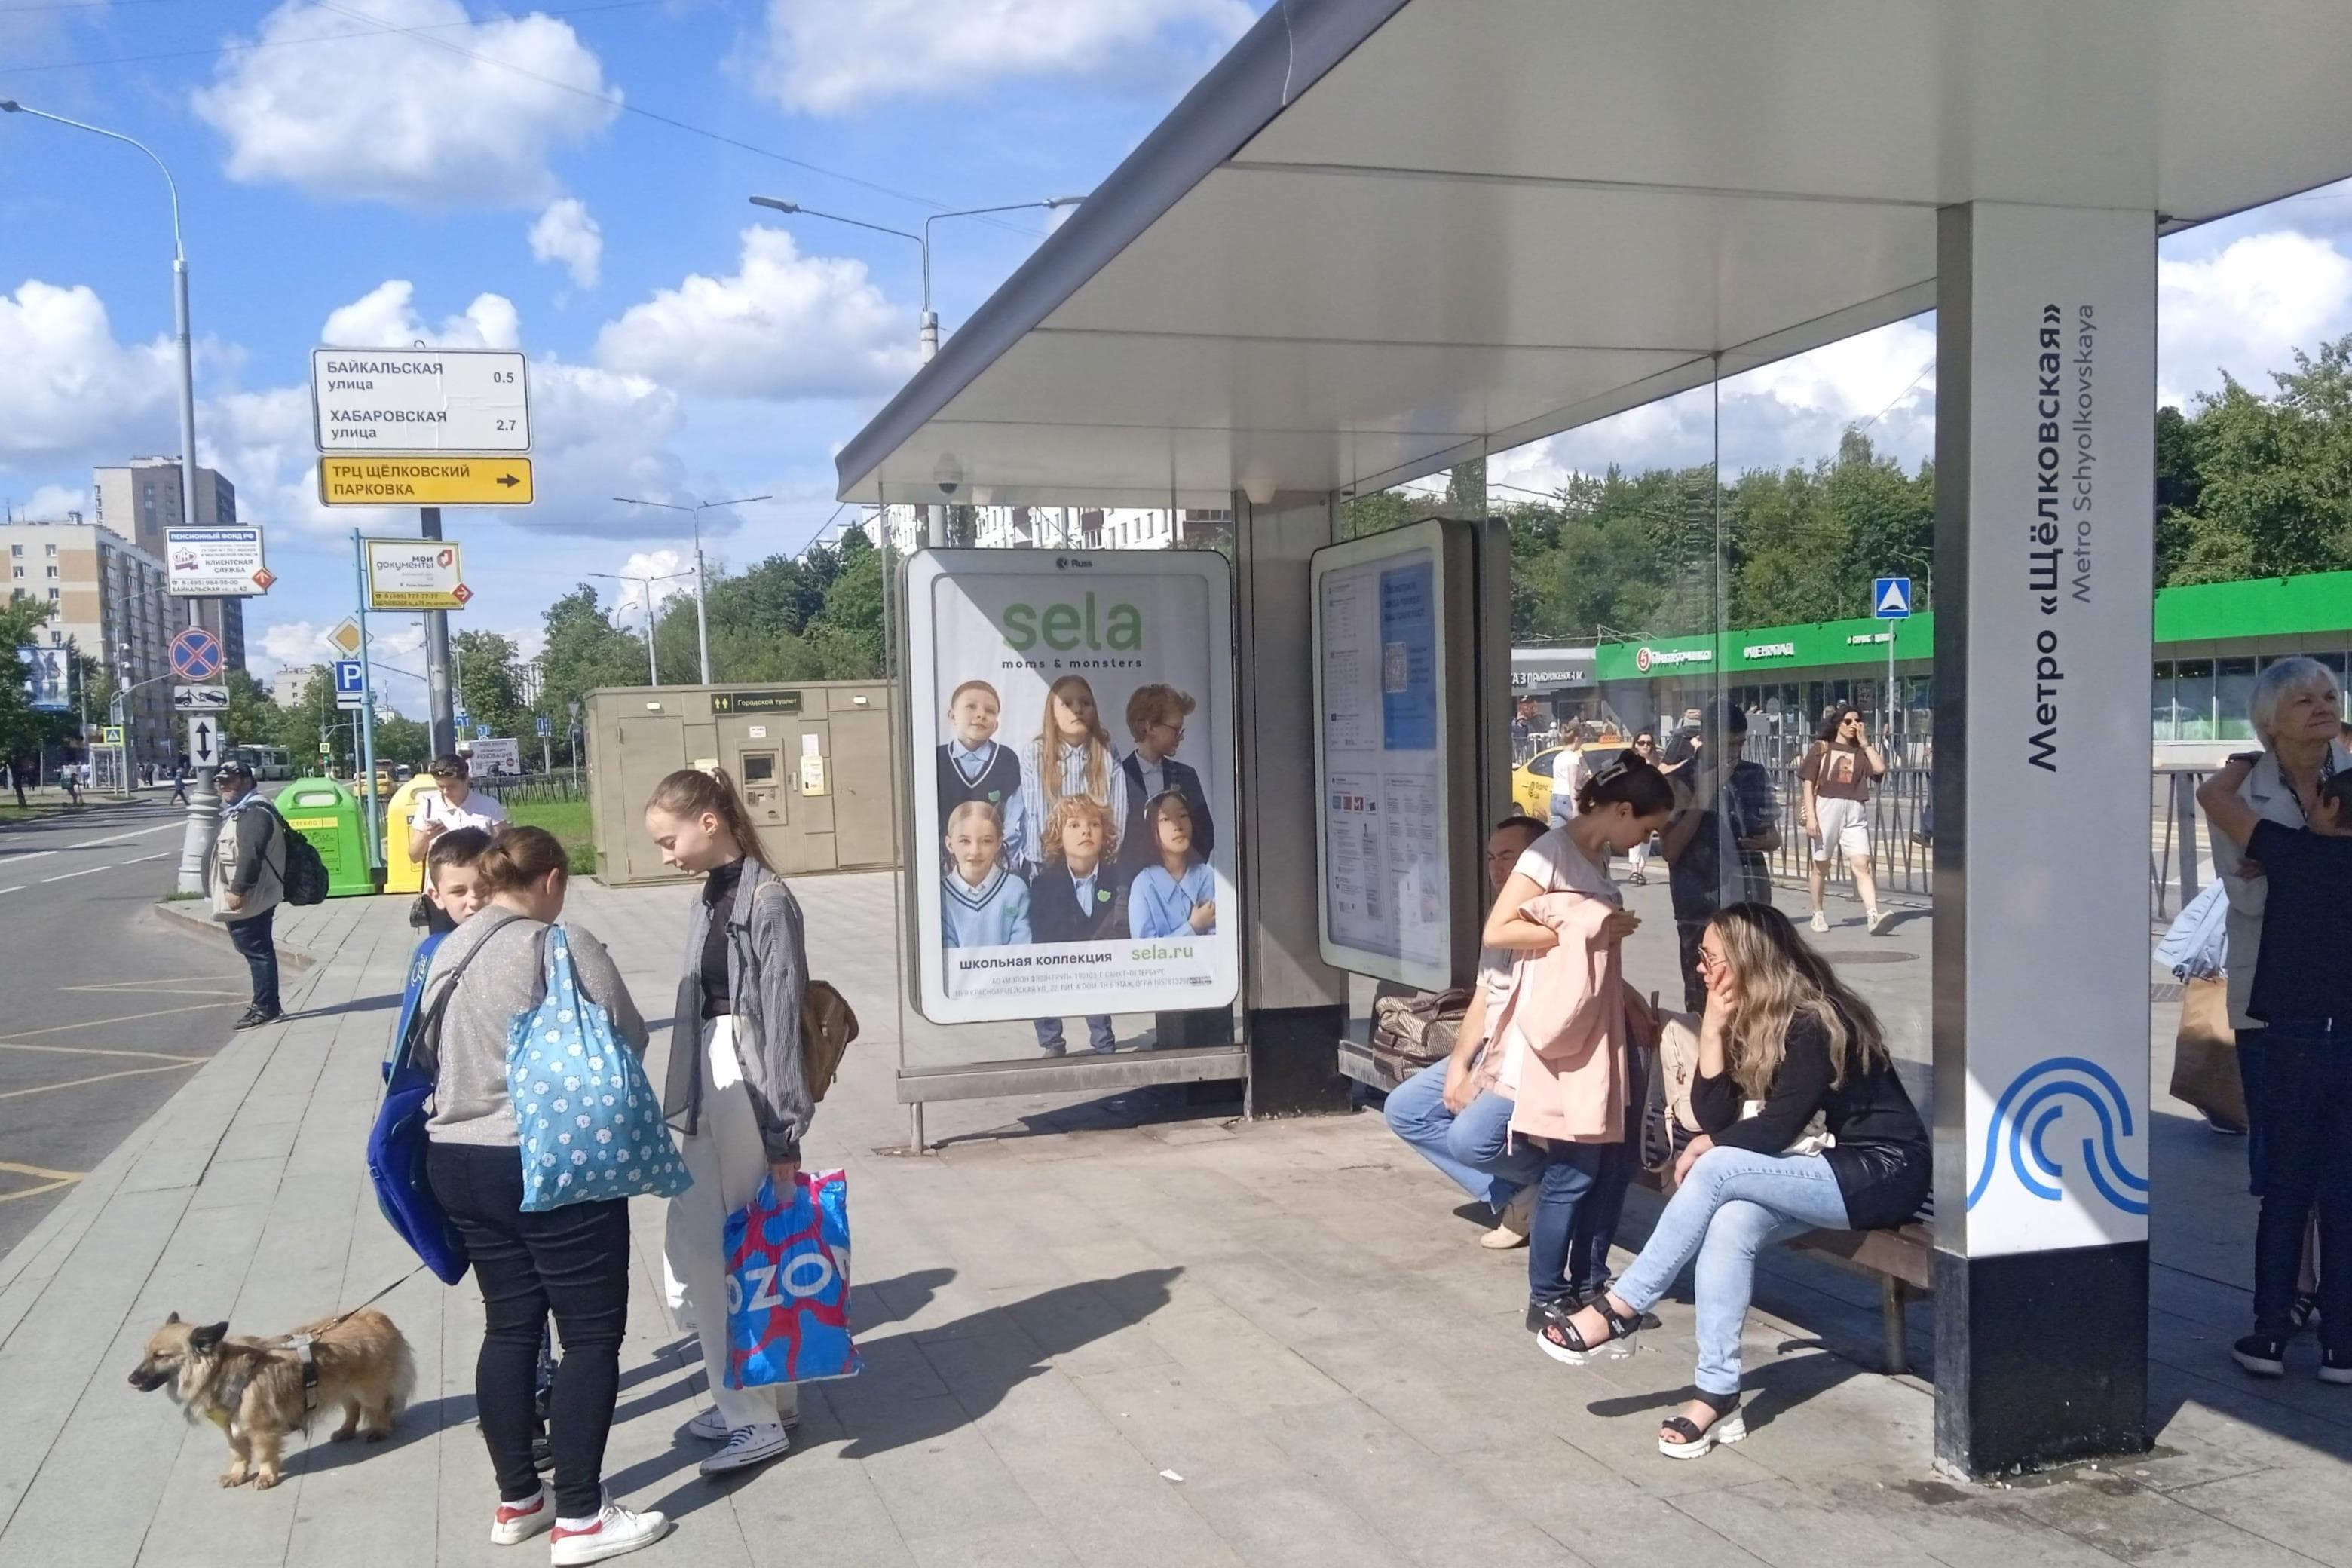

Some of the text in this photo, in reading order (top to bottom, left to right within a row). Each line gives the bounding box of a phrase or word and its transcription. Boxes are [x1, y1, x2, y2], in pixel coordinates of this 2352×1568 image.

[327, 360, 443, 375] БАЙКАЛЬСКАЯ
[493, 372, 514, 384] 0.5
[328, 380, 374, 392] улица
[330, 410, 447, 422] ХАБАРОВСКАЯ
[496, 419, 516, 431] 2.7
[332, 429, 377, 440] улица
[2072, 304, 2098, 603] Metro Schyolkovskaya
[332, 464, 470, 479] ТРЦ ЩЁЛКОВСКИЙ
[334, 484, 415, 495] ПАРКОВКА
[2029, 303, 2064, 773] Метро «Щёлковская»
[376, 562, 434, 571] документы
[1071, 559, 1093, 568] Russ
[1002, 591, 1141, 651] sela
[1002, 657, 1142, 669] moms & monsters
[737, 697, 797, 706] Городской туалет
[1132, 943, 1194, 960] sela.ru
[960, 952, 1113, 970] школьная коллекция
